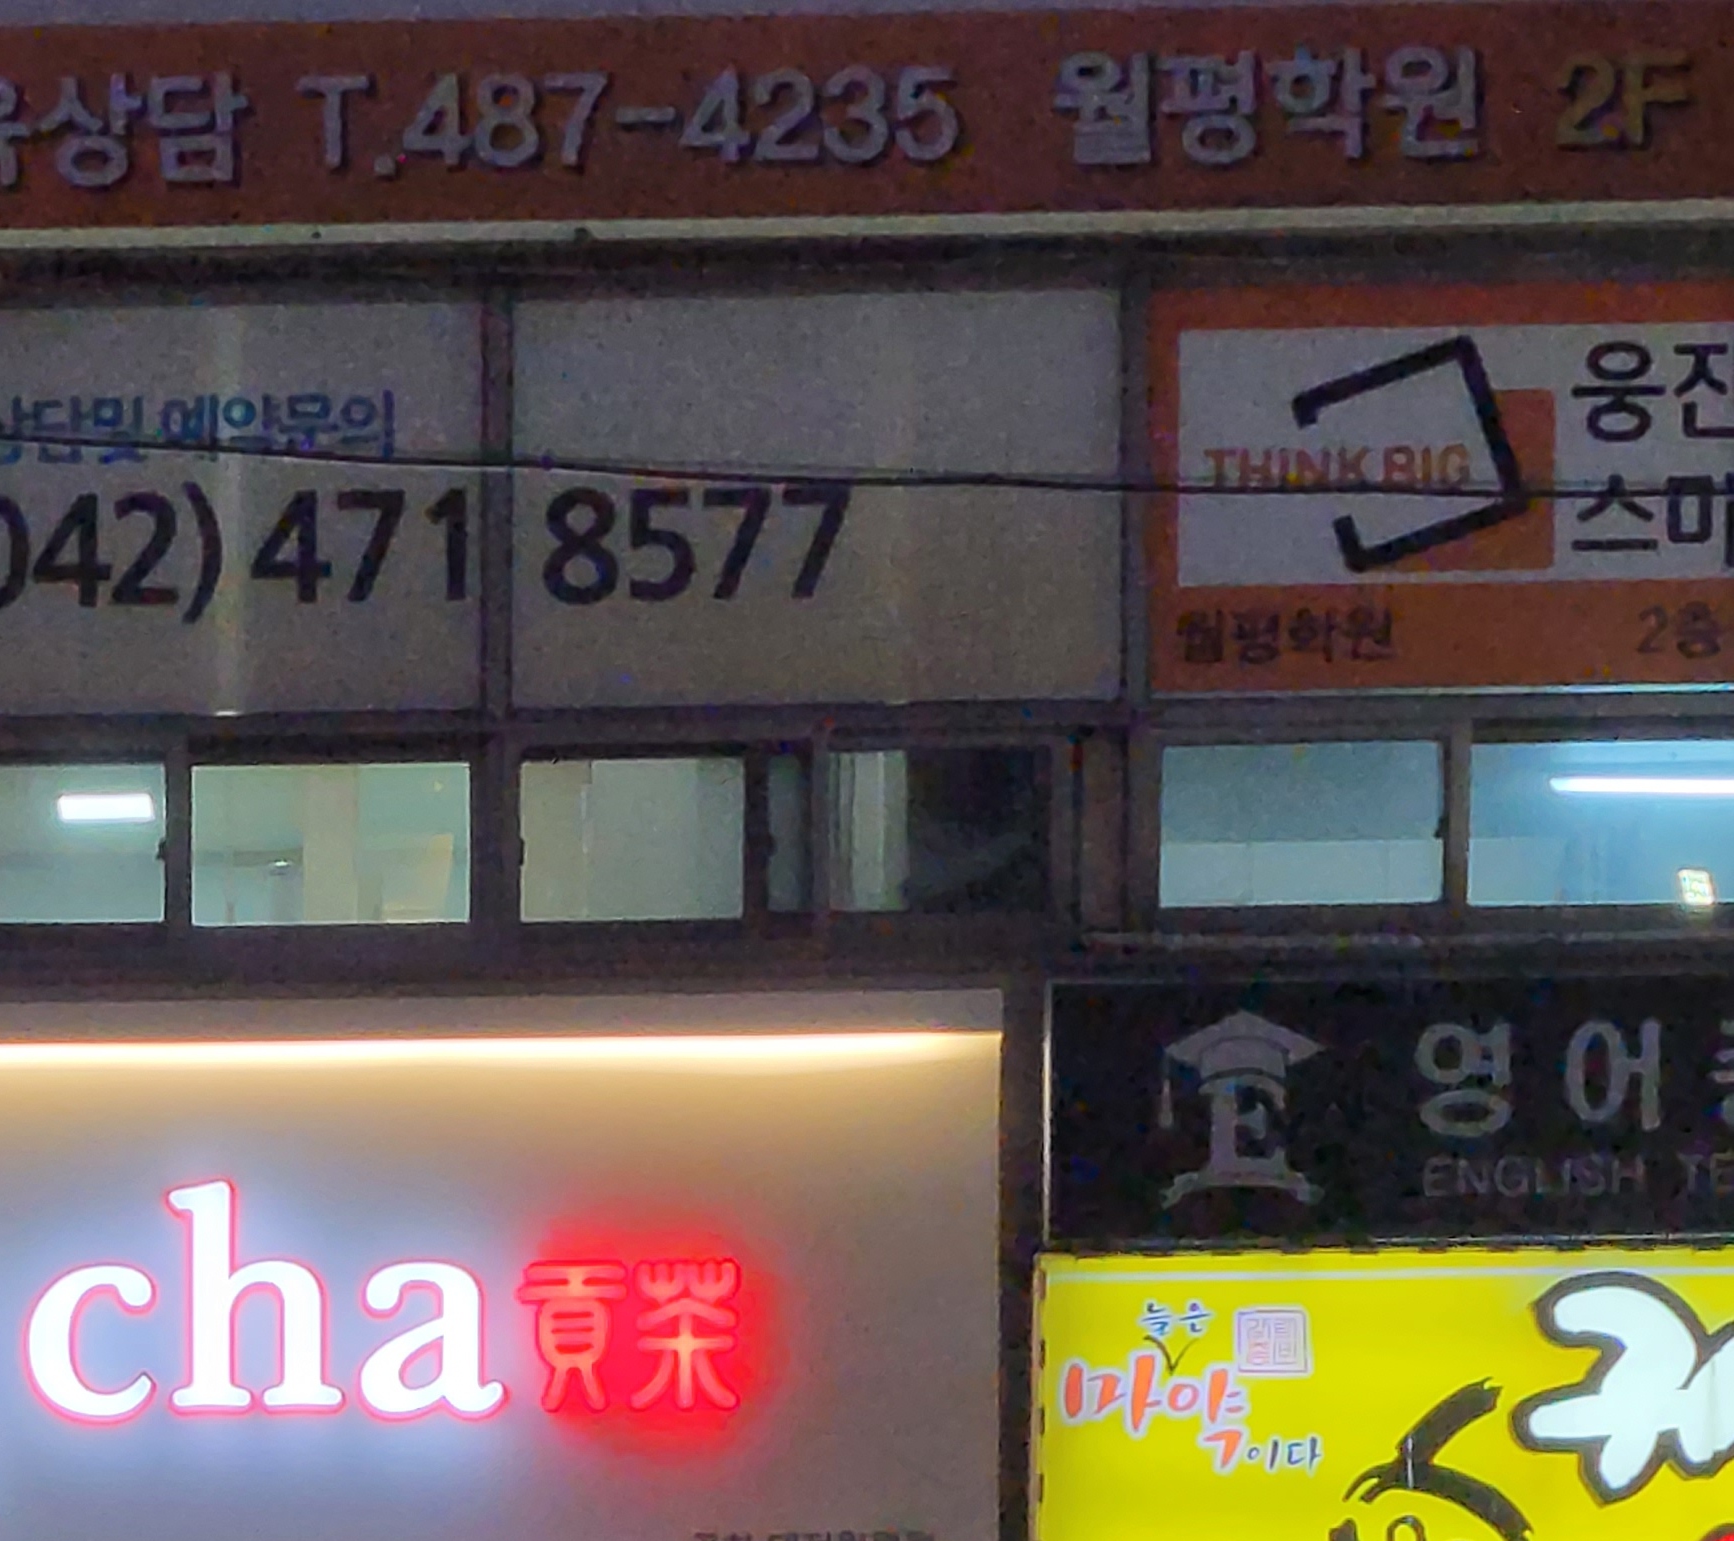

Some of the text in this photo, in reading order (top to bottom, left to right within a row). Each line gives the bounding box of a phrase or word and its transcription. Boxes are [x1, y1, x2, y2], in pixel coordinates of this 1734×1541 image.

[296, 68, 962, 182] T.487-4235
[1054, 46, 1482, 166] 월평학원
[1558, 54, 1694, 148] 2F
[250, 488, 468, 602] 471
[540, 484, 854, 604] 8577
[1422, 1154, 1646, 1198] ENGLISH
[24, 1180, 508, 1424] cha
